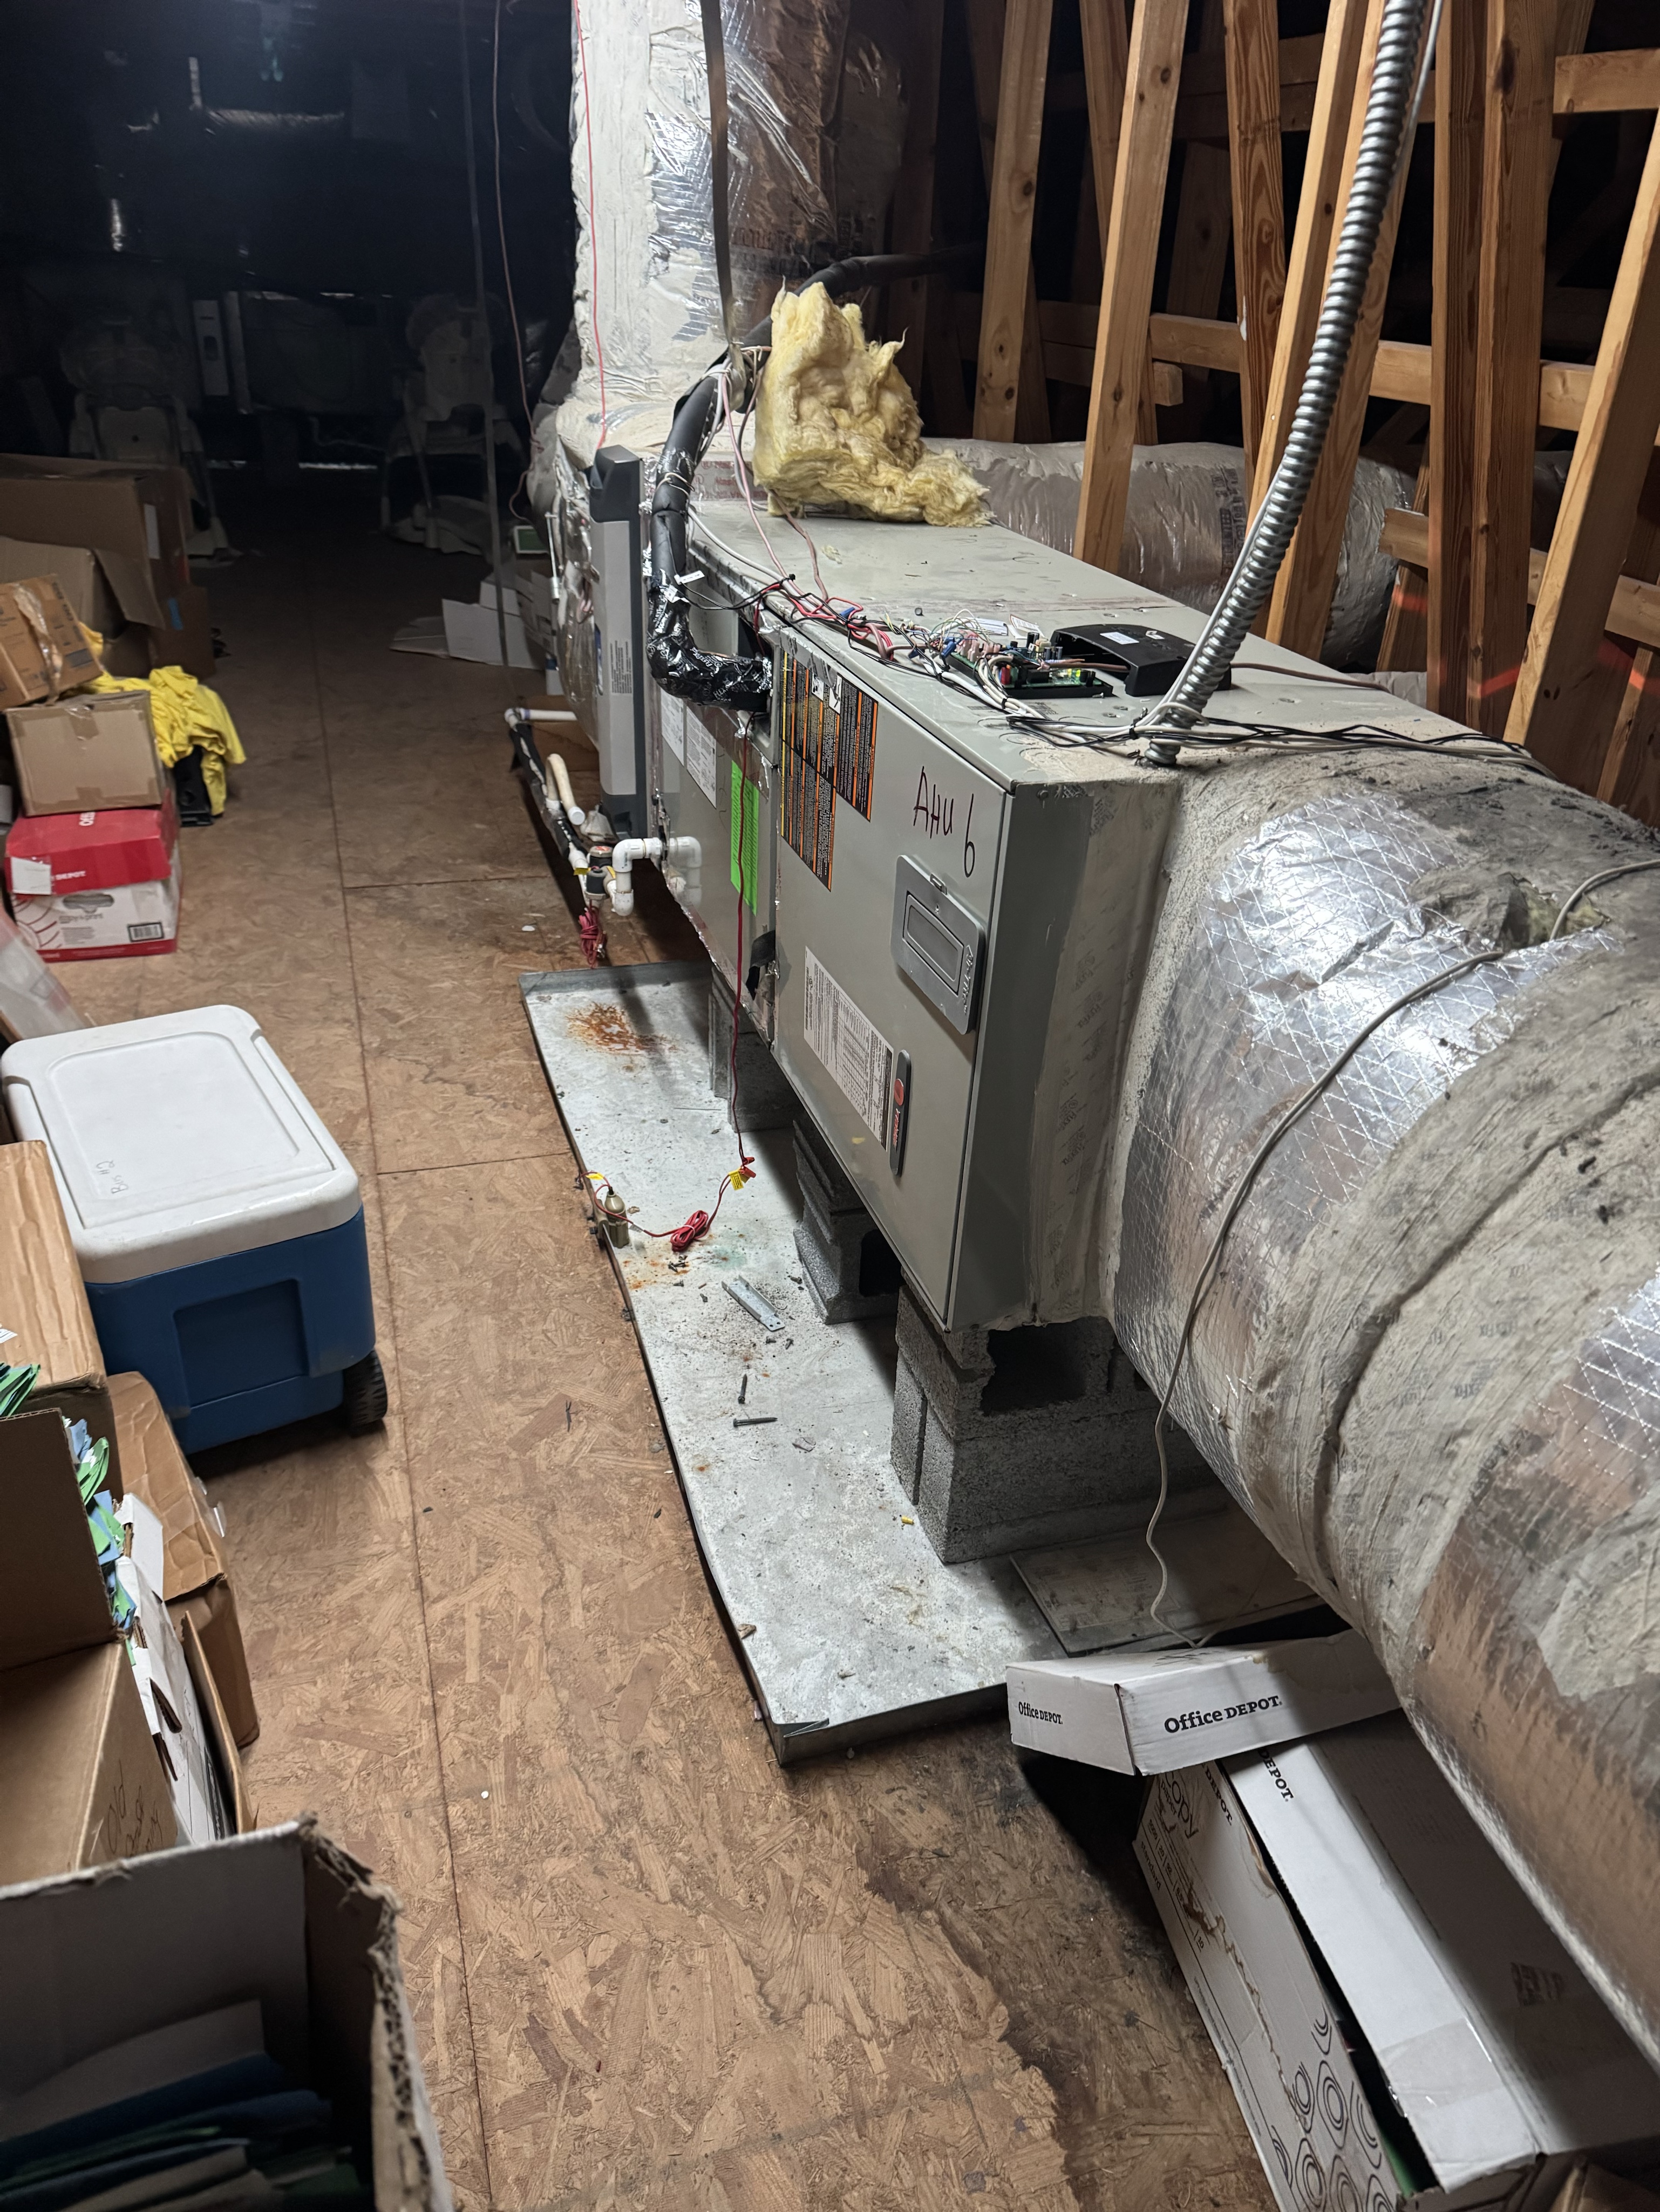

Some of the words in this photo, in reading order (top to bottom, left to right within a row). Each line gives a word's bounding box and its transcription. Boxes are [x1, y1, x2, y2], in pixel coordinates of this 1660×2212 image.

[913, 766, 954, 839] AHU
[964, 793, 975, 878] 6
[1018, 1701, 1039, 1719] Office
[1164, 1710, 1223, 1733] Office
